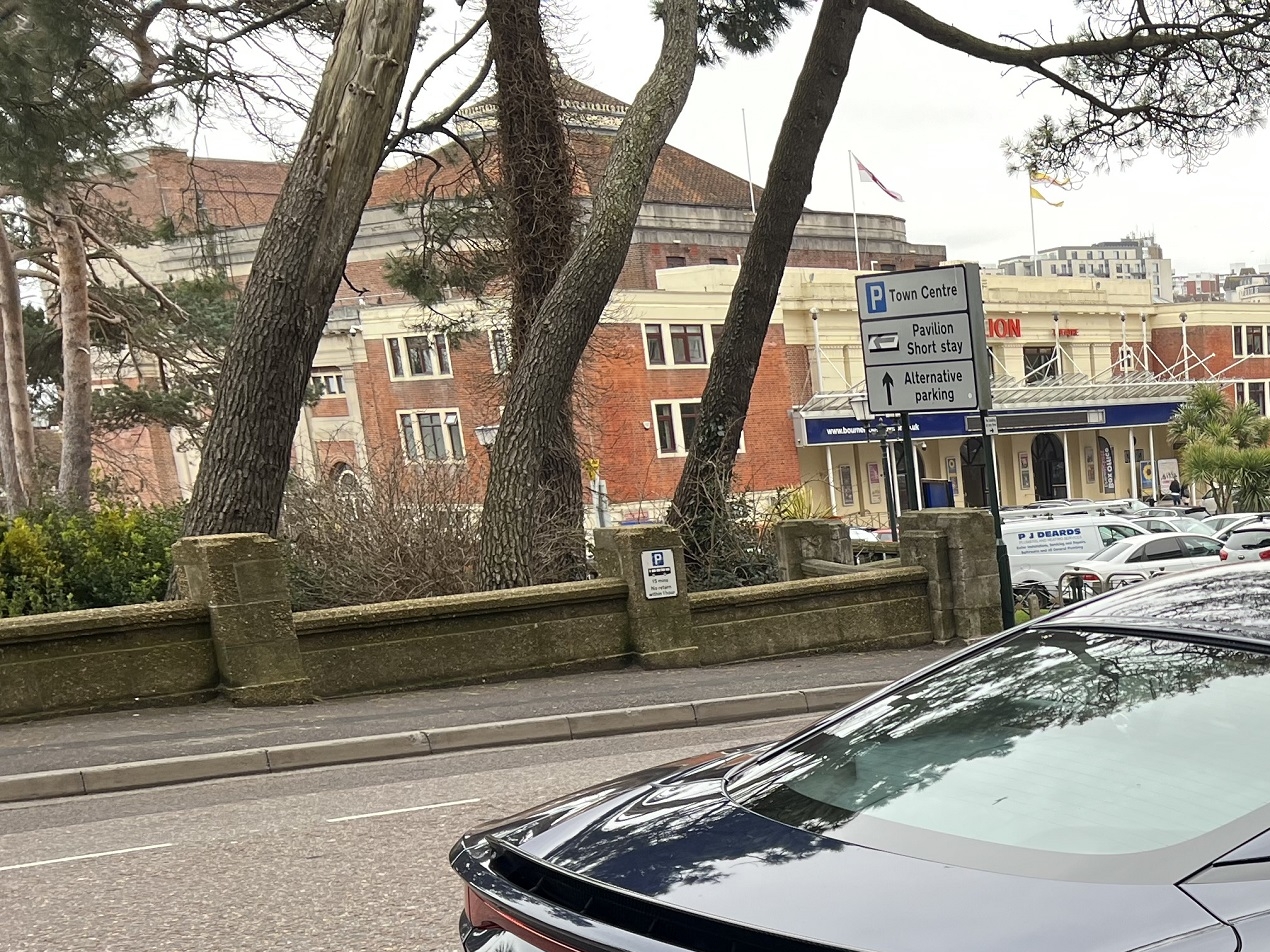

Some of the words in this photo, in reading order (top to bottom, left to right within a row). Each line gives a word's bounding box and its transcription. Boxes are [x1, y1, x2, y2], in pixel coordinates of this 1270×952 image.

[870, 285, 883, 311] P
[889, 289, 918, 302] Town
[921, 284, 958, 299] Centre
[912, 322, 954, 337] Pavilion
[907, 341, 937, 355] Short
[941, 340, 963, 354] stay
[904, 369, 963, 385] Alternative
[915, 388, 955, 404] parking
[1037, 528, 1081, 538] DEARDS
